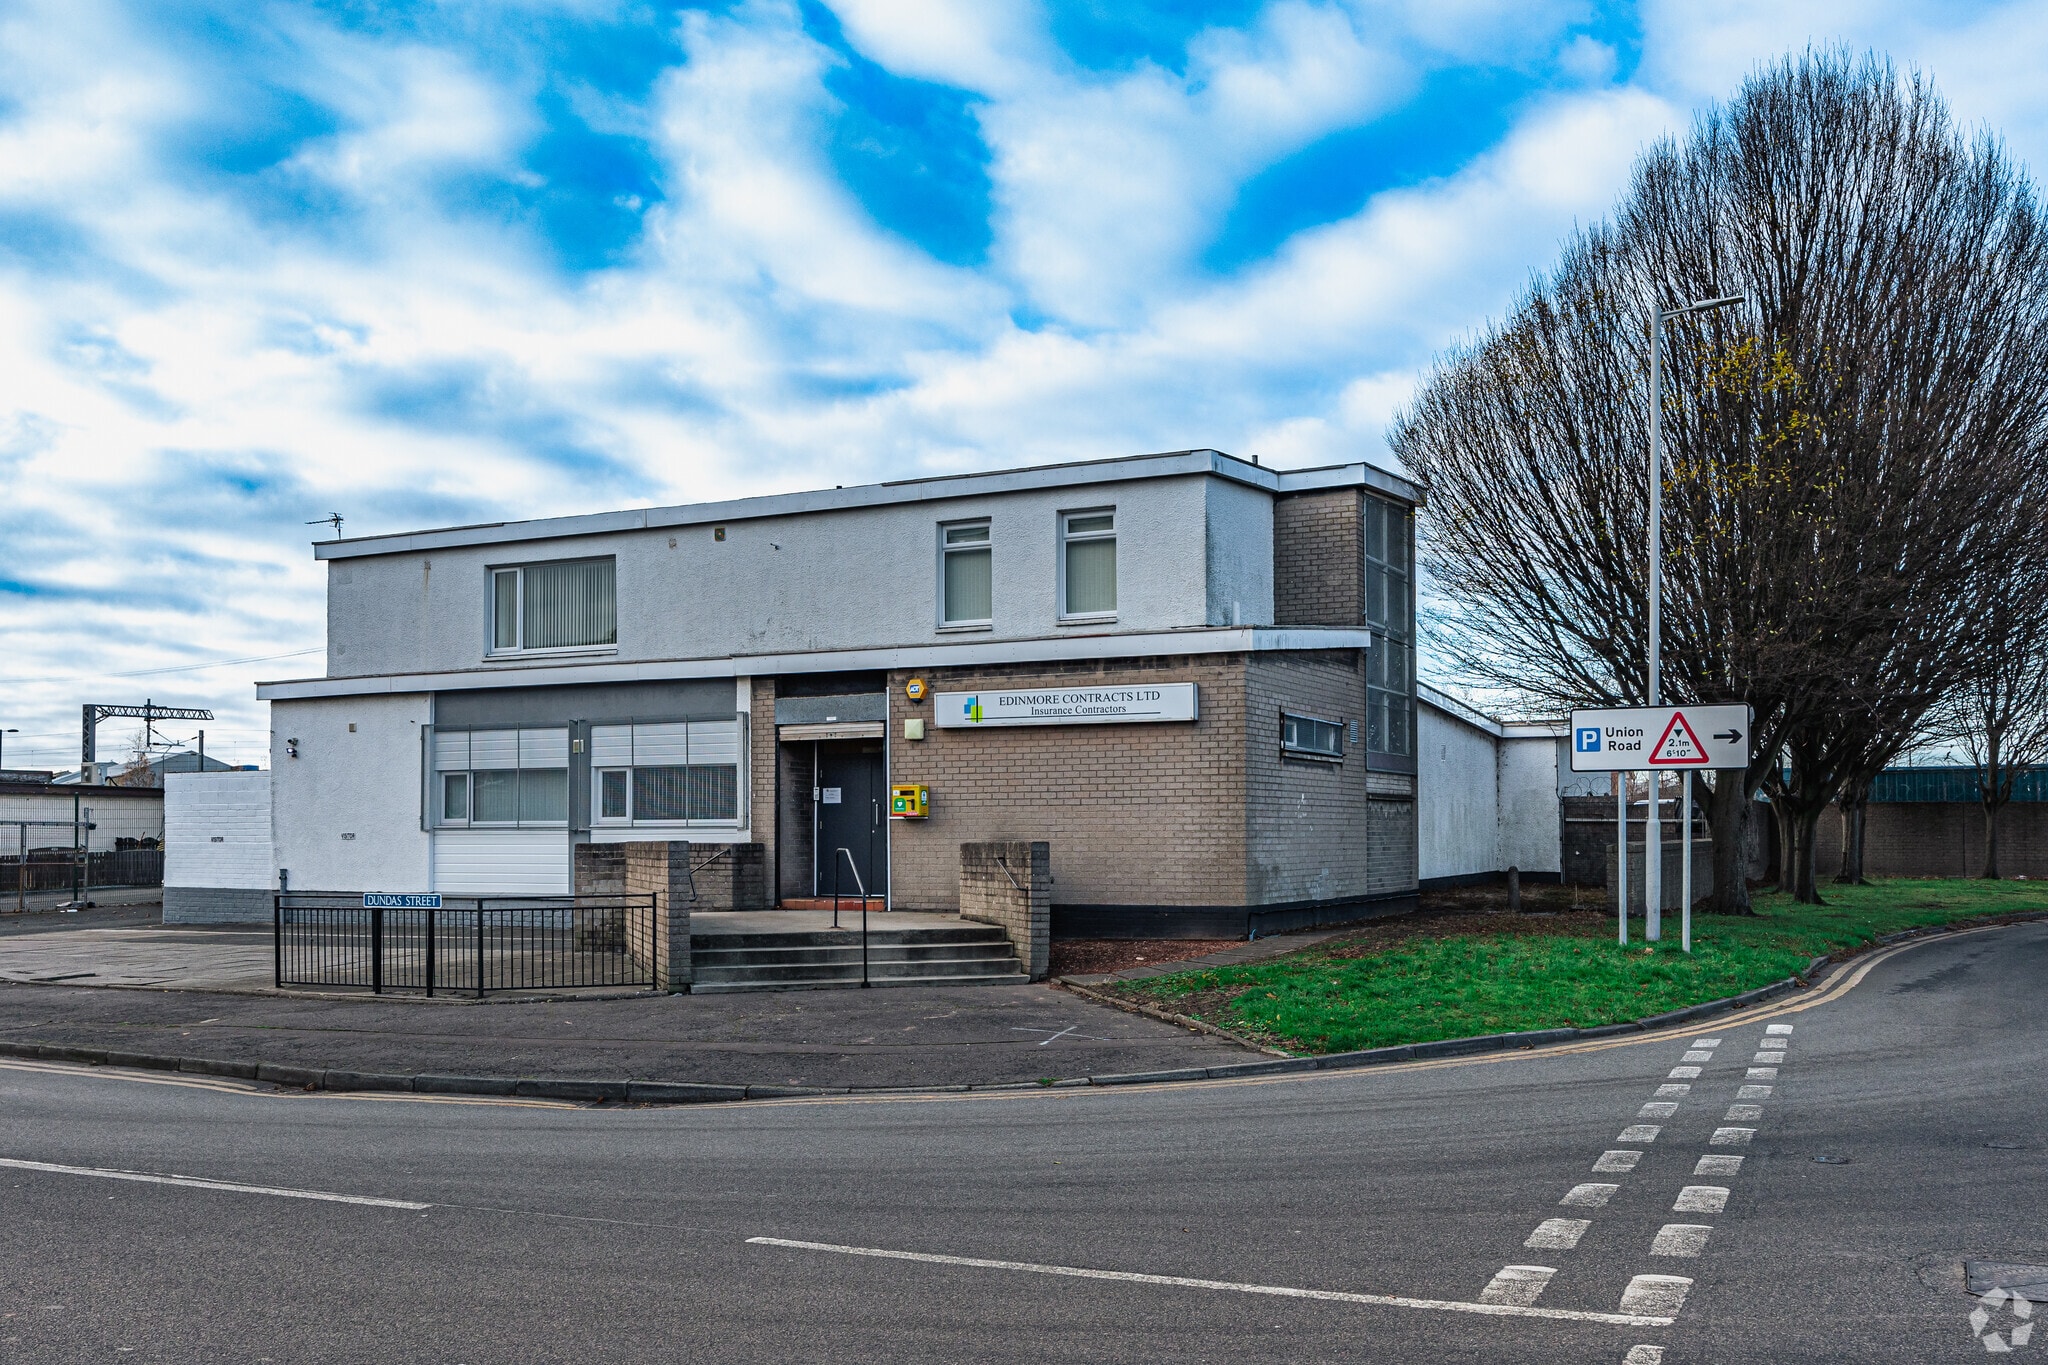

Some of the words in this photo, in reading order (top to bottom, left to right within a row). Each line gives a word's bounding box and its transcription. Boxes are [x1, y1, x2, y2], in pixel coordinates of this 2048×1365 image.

[999, 695, 1060, 706] EDINMORE
[1062, 691, 1134, 704] CONTRACTS
[1136, 690, 1161, 701] LTD
[1031, 706, 1073, 716] Insurance
[1075, 704, 1127, 715] Contractors
[1605, 727, 1644, 738] Union
[1582, 730, 1597, 750] P
[1608, 740, 1642, 751] Road
[1668, 738, 1690, 748] 2.1m
[367, 895, 402, 906] DUNDAS
[405, 896, 438, 906] STREET
